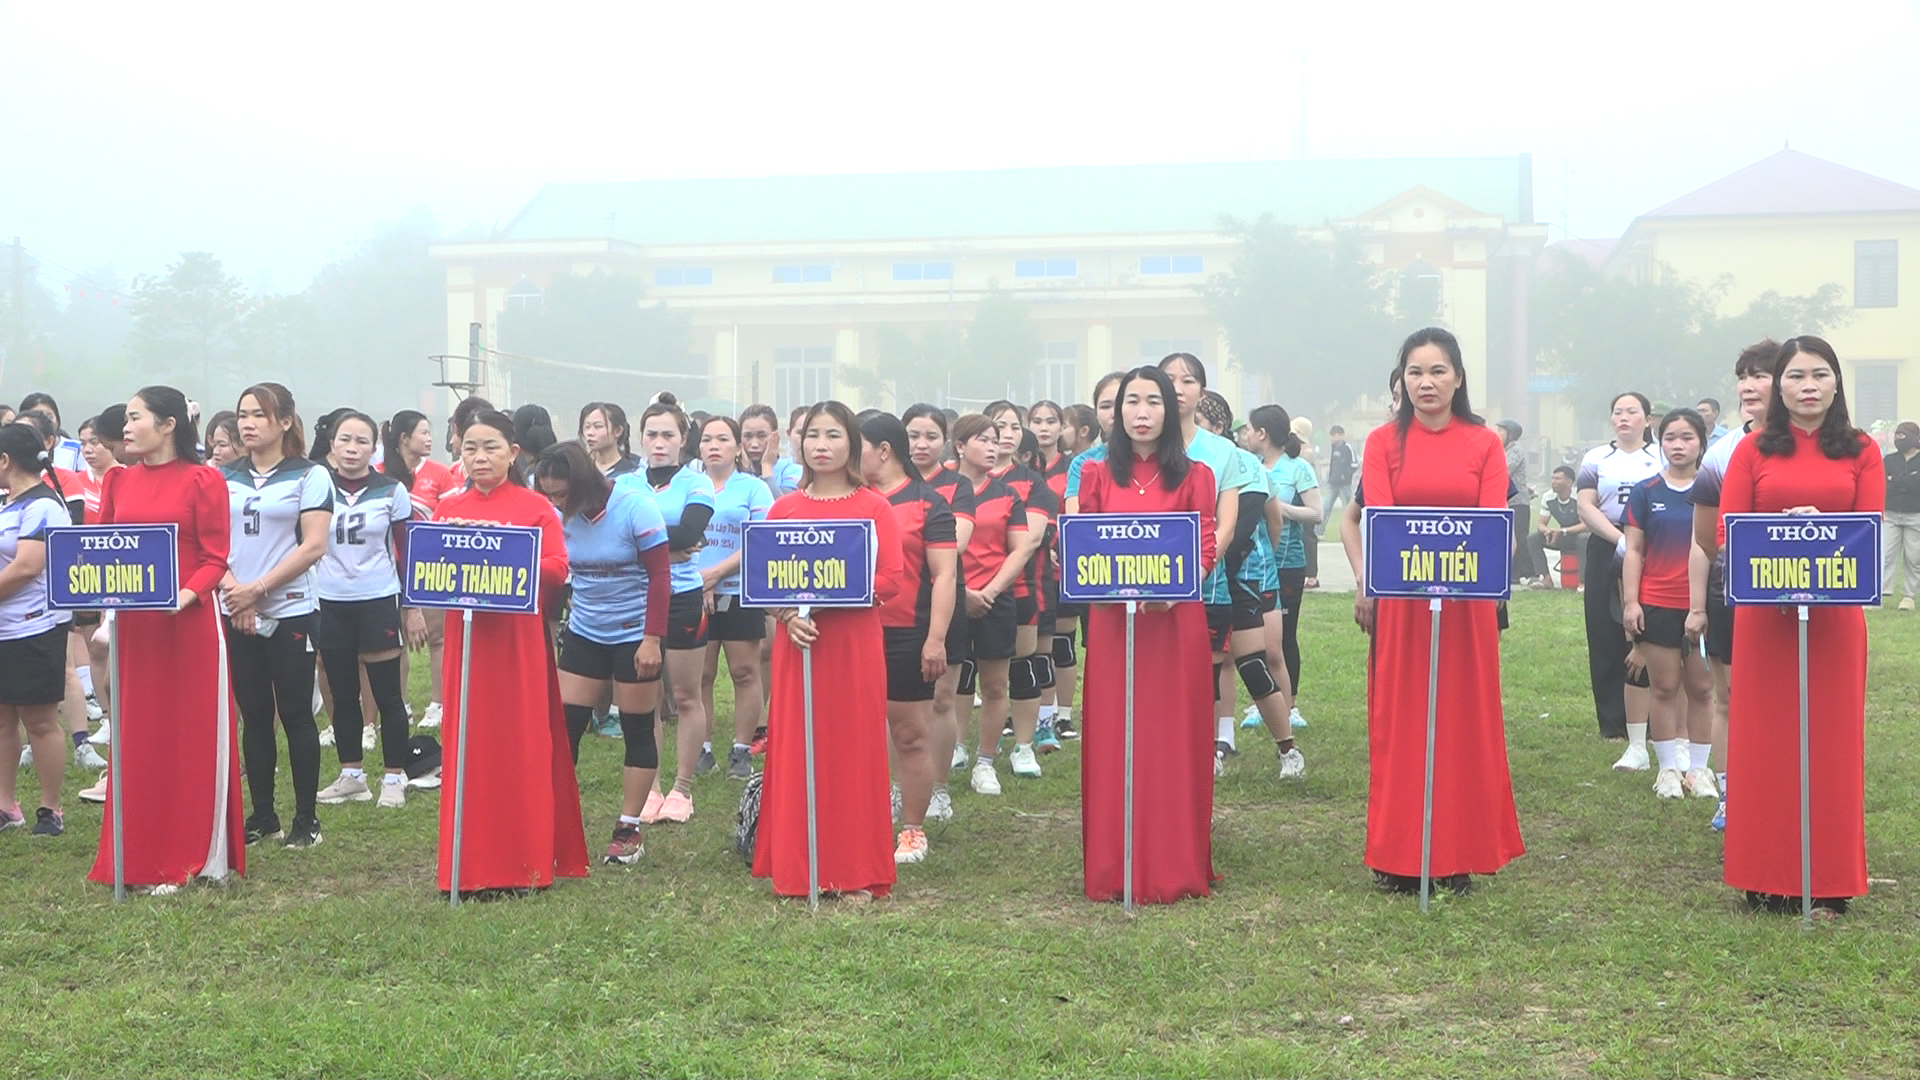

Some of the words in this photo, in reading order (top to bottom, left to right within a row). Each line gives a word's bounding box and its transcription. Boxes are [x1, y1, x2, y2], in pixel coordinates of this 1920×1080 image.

[243, 496, 261, 536] 5
[336, 511, 366, 545] 12
[1097, 521, 1161, 539] THÔN
[1406, 516, 1473, 535] THÔN
[1767, 521, 1838, 541] THÔN
[80, 531, 140, 550] THÔN
[441, 531, 503, 550] THÔN
[775, 526, 836, 545] THÔN
[69, 563, 101, 594] SƠN
[105, 558, 143, 593] BÌNH
[147, 564, 155, 592] 1
[413, 556, 457, 592] PHÚC
[461, 559, 513, 595] THÀNH
[515, 567, 528, 596] 2
[767, 553, 809, 589] PHÚC
[813, 557, 846, 589] SƠN
[1077, 553, 1111, 586] SƠN
[1115, 554, 1171, 585] TRUNG
[1175, 555, 1184, 584] 1
[1400, 544, 1435, 581] TÂN
[1439, 541, 1478, 582] TIẾN
[1750, 557, 1811, 589] TRUNG
[1815, 546, 1857, 589] TIẾN
